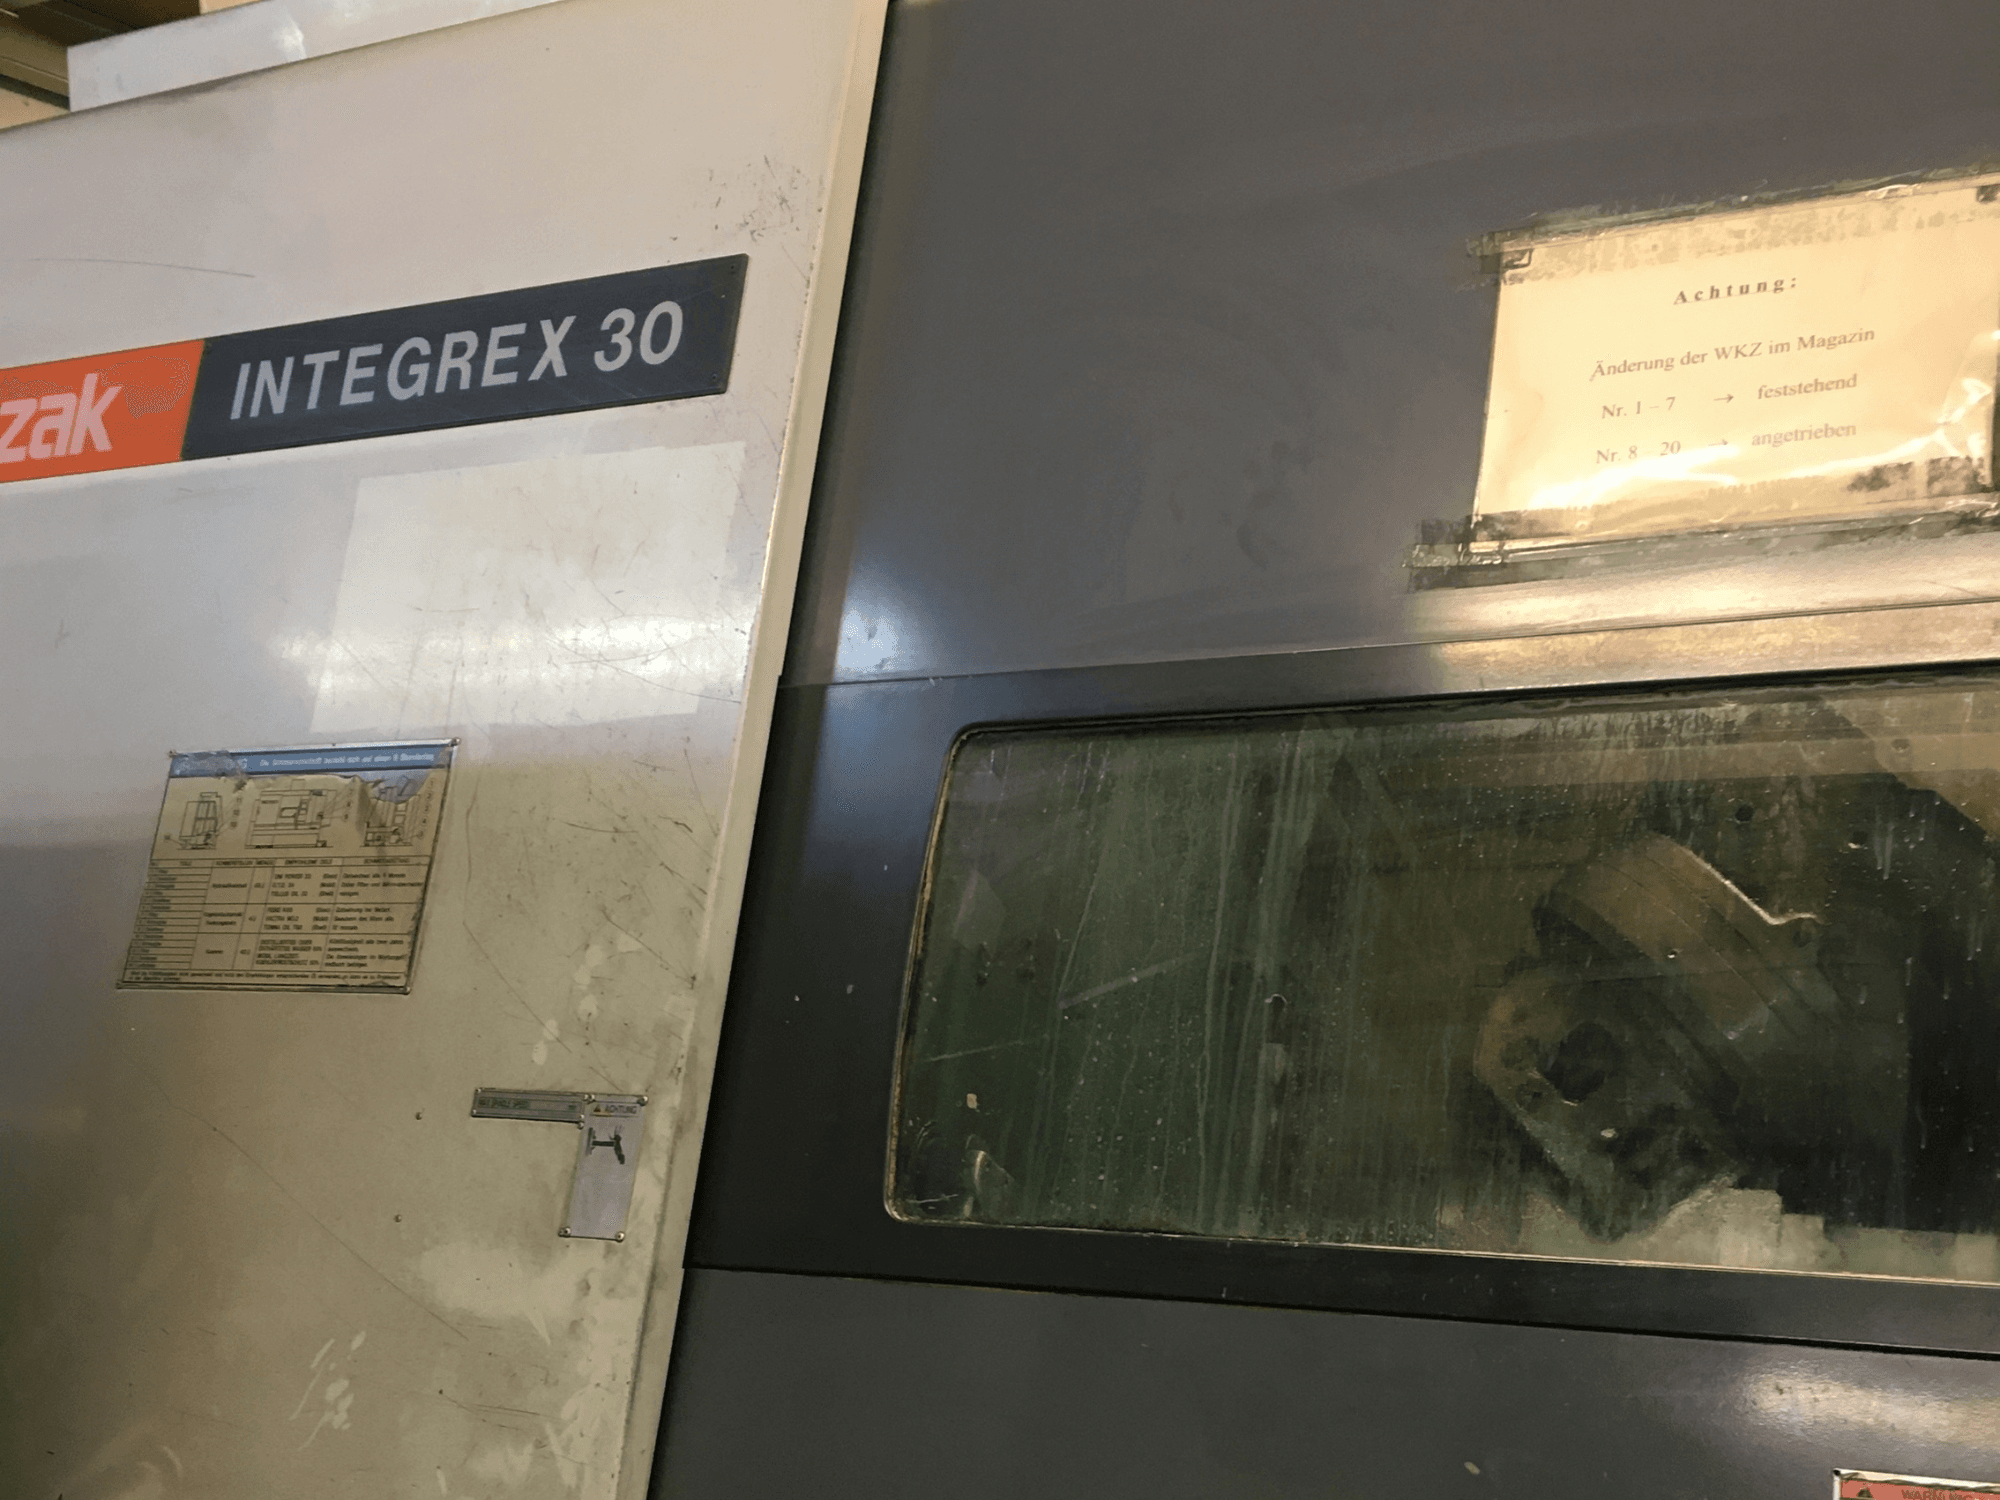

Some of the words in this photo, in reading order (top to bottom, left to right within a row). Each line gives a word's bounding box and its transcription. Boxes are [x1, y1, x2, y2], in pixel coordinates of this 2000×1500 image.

[1673, 277, 1797, 304] Achtung:
[230, 315, 576, 420] INTEGREX
[594, 300, 684, 372] 30
[1590, 356, 1675, 381] Änderung
[1680, 350, 1708, 366] der
[1714, 342, 1763, 361] WKZ
[1769, 340, 1791, 354] im
[1797, 328, 1875, 350] Magazin
[1601, 404, 1627, 419] Nr.
[1635, 400, 1642, 415] 1
[1666, 396, 1676, 411] 7
[1757, 373, 1858, 400] feststehend
[1596, 449, 1621, 464] Nr.
[1628, 445, 1638, 459] 8
[1660, 440, 1681, 456] 20
[1751, 423, 1857, 448] angetrieben
